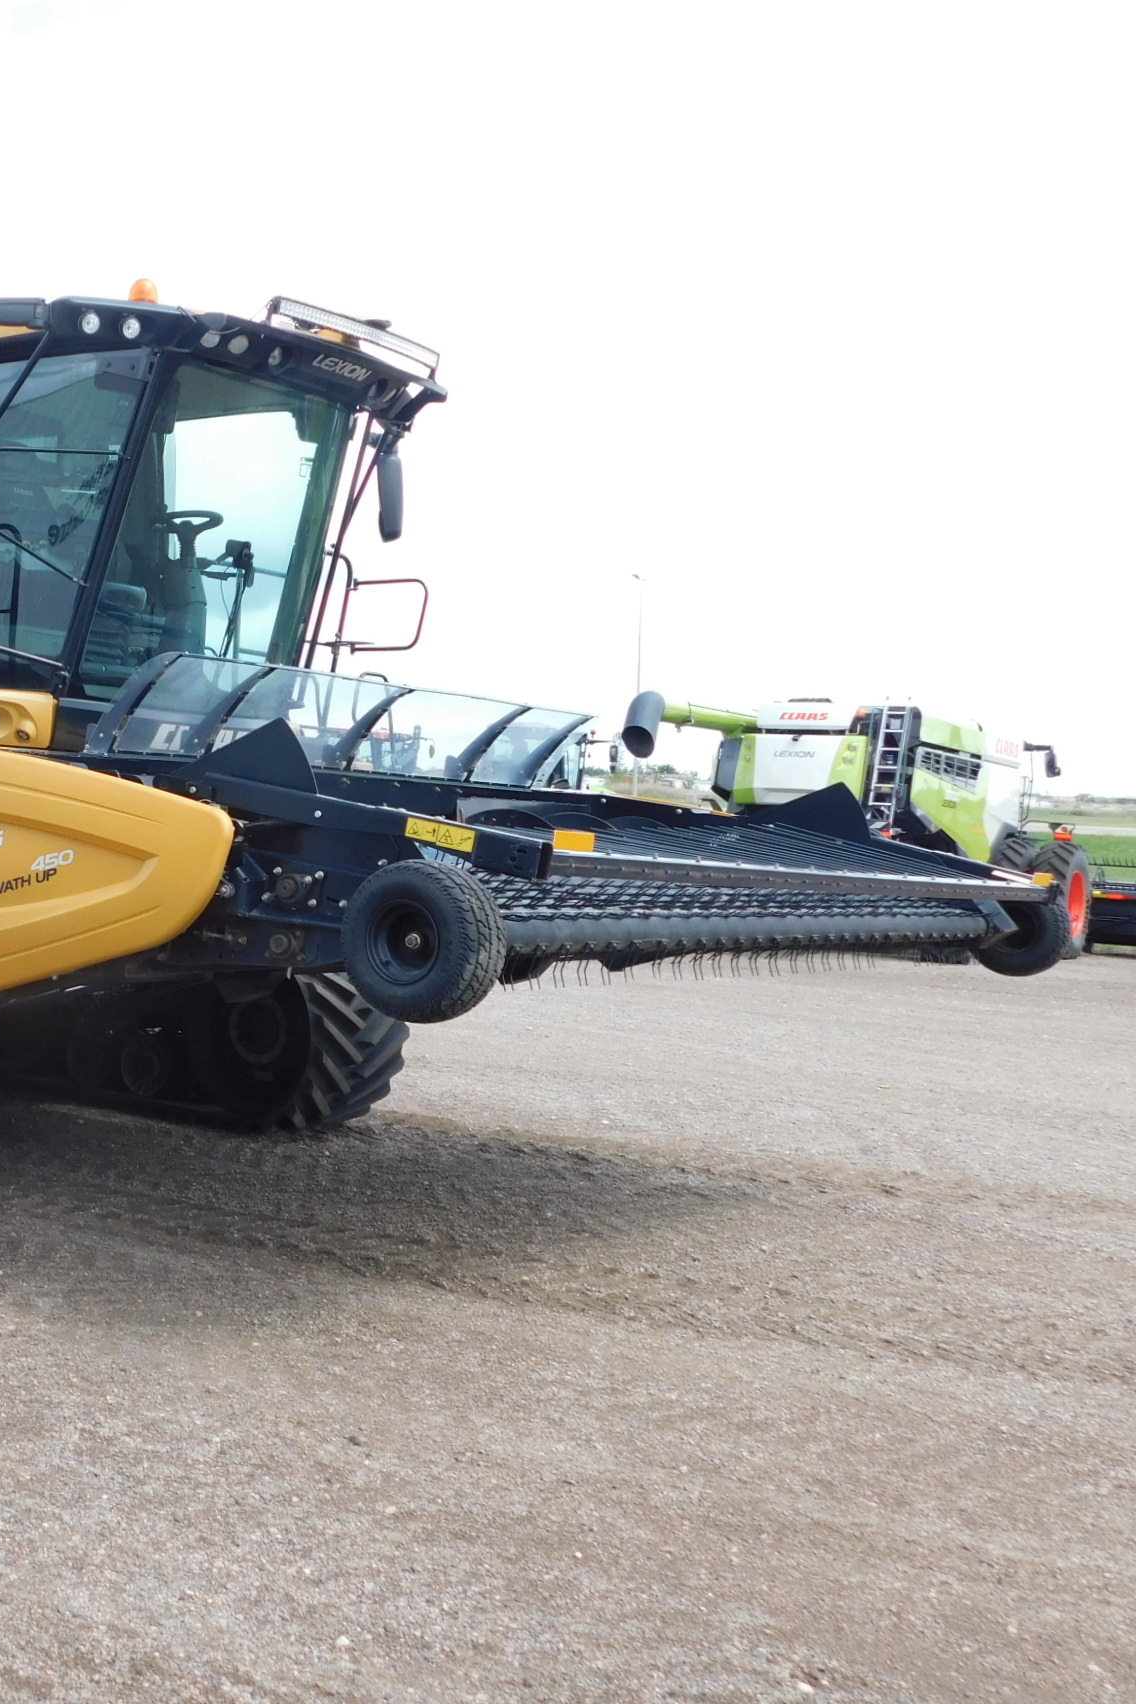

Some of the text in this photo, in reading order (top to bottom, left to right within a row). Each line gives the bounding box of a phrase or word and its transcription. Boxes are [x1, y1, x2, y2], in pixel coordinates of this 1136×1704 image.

[312, 354, 373, 382] LEXION
[779, 712, 829, 720] CLAAS
[773, 750, 815, 758] LEXION
[995, 738, 1019, 759] CLAAS
[30, 849, 75, 872] 450
[35, 867, 58, 884] UP
